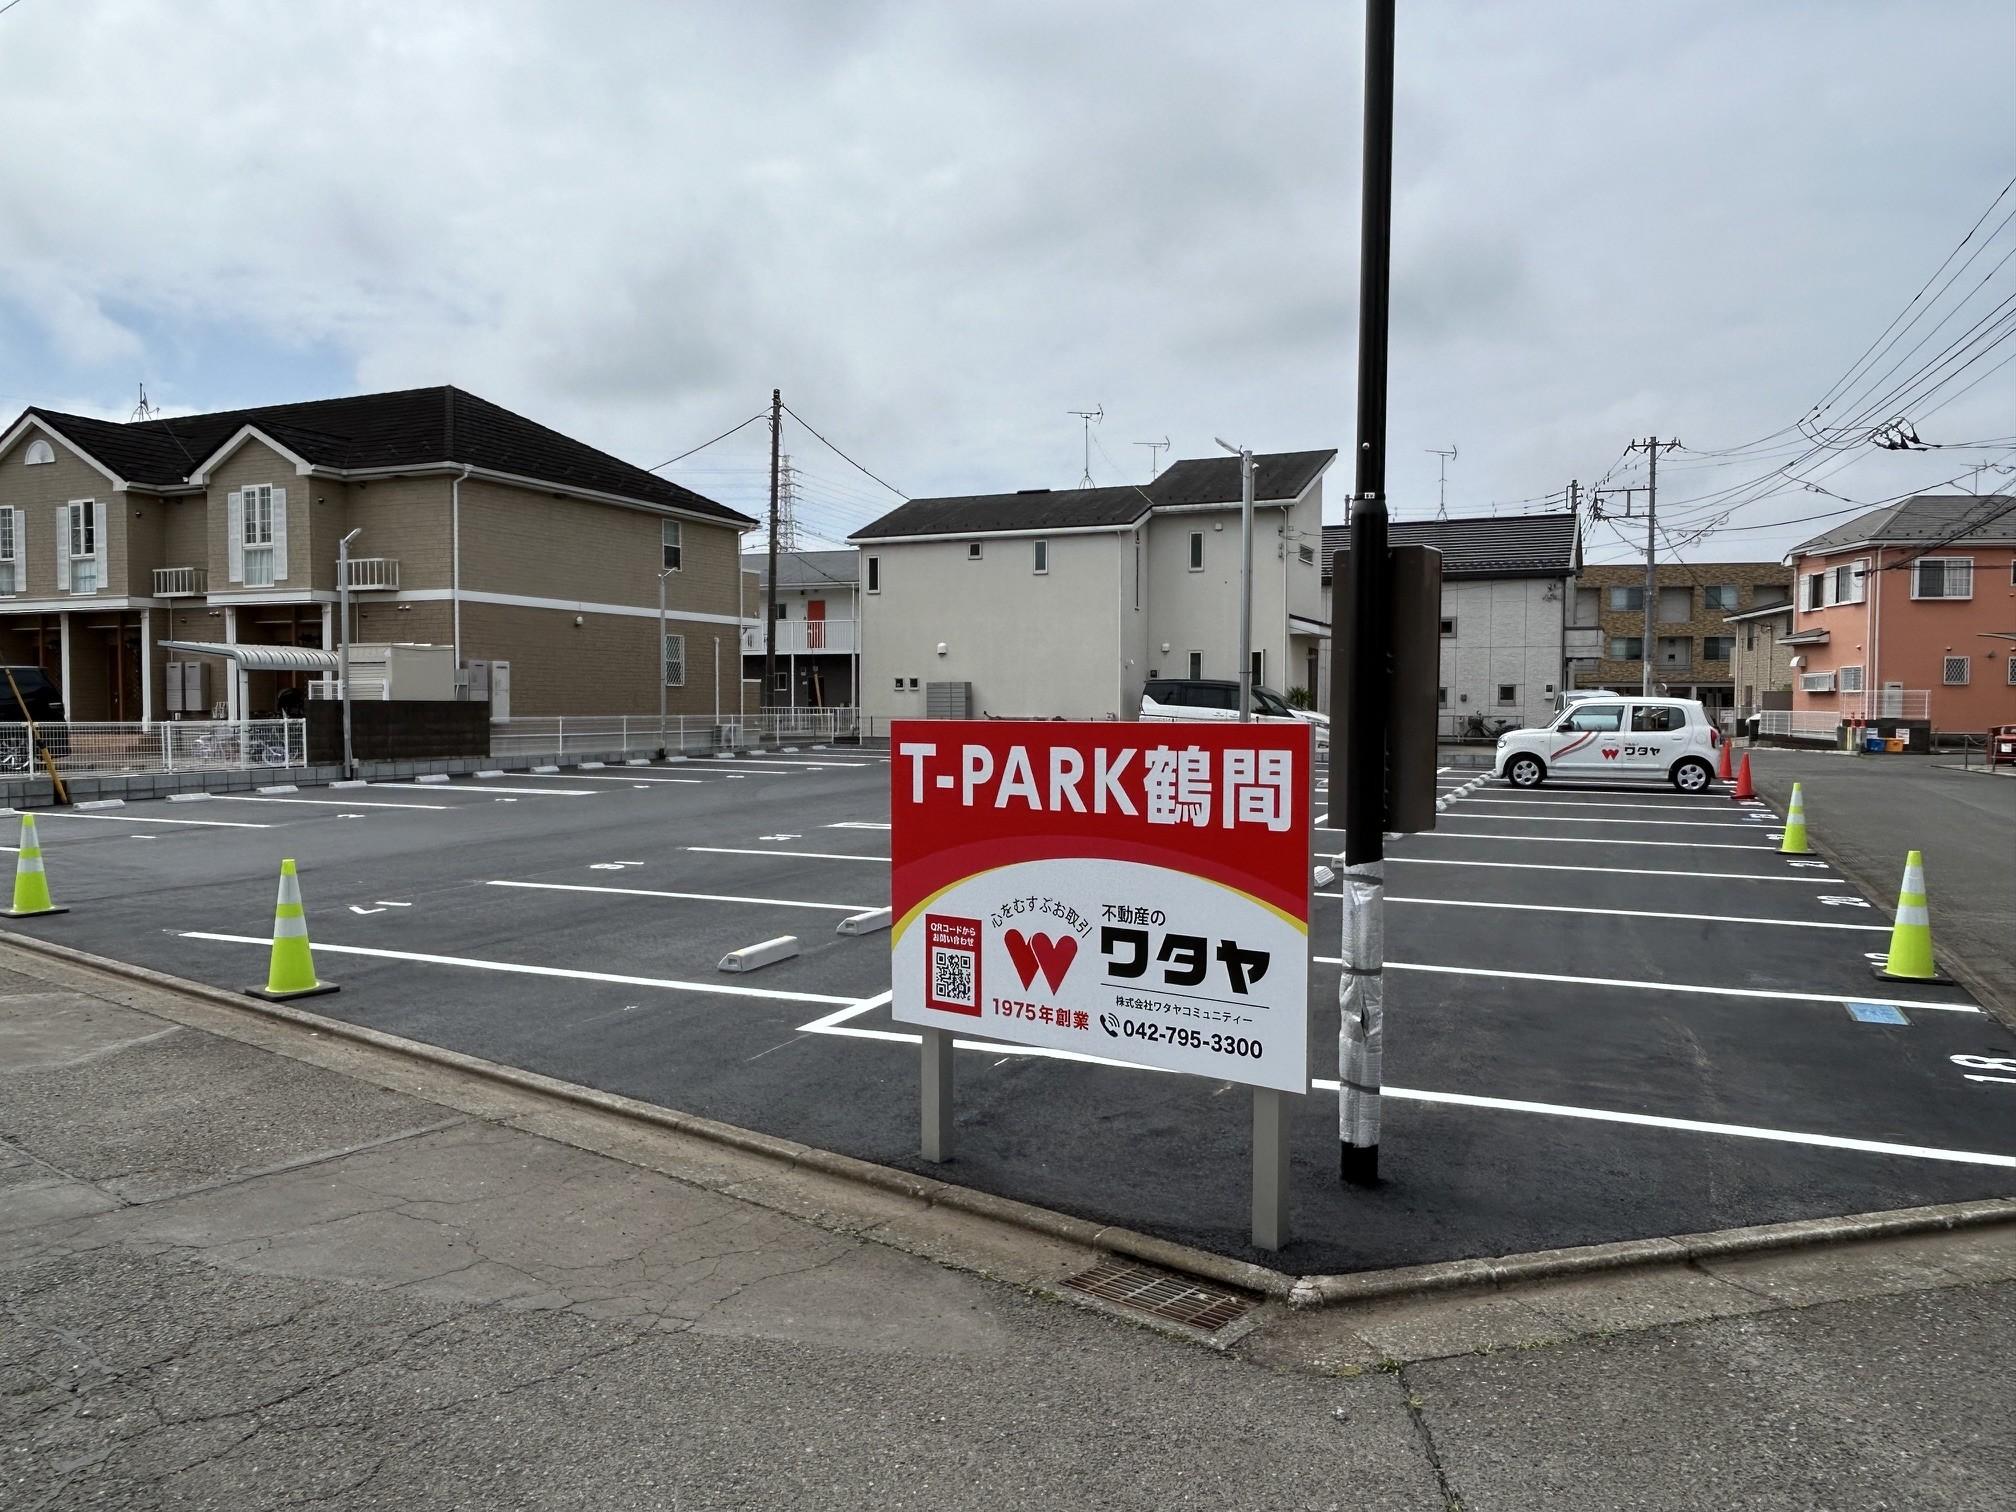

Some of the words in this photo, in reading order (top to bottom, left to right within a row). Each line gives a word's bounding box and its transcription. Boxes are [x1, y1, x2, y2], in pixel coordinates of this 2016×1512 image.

[1624, 747, 1660, 756] ワタヤ
[899, 742, 1293, 832] T-PARK鶴間
[991, 896, 1093, 938] 心をむすぶお取引
[1101, 904, 1166, 926] 不動産の
[1101, 926, 1270, 995] ワタヤ
[992, 997, 1090, 1031] 1975年創業
[1116, 995, 1253, 1025] 株式会社ワタヤコミュニティー
[1123, 1019, 1263, 1059] 042-795-3300
